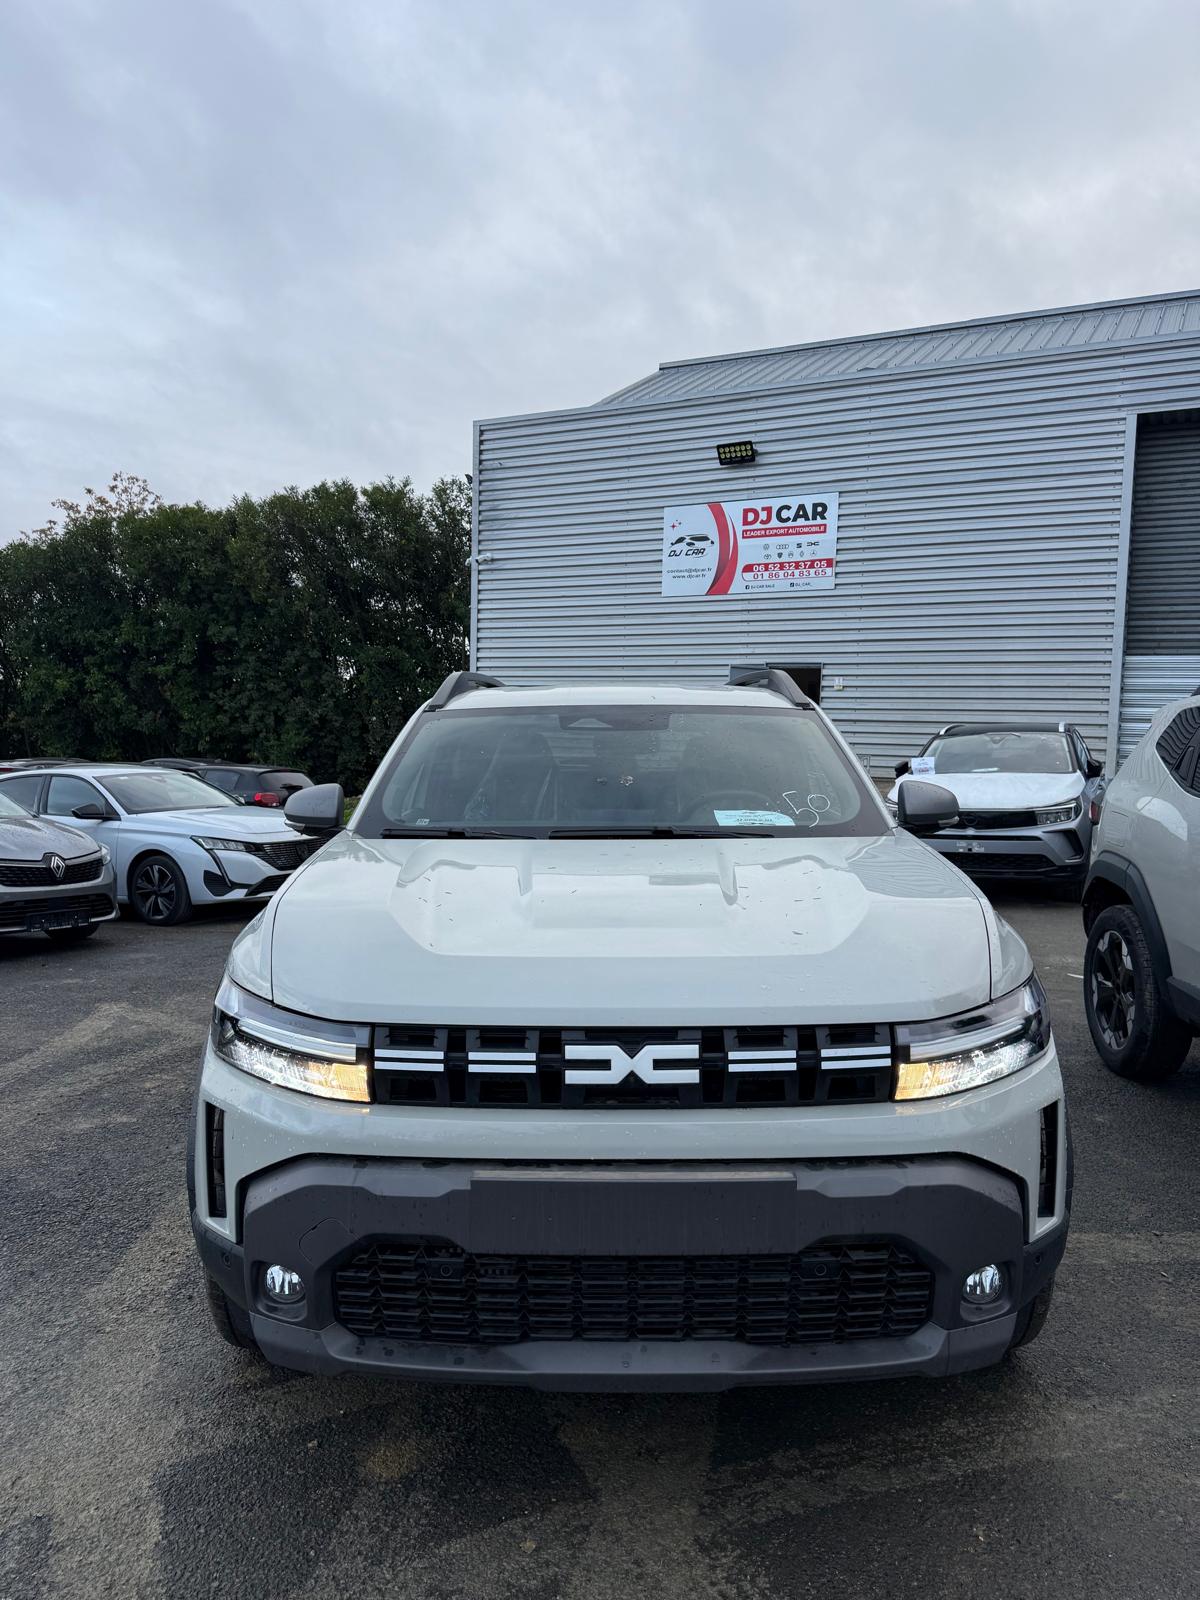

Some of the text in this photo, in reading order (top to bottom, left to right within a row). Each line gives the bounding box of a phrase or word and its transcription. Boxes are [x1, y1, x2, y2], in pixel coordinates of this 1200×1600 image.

[742, 502, 828, 526] DJ CAR
[668, 548, 706, 558] DJ CAR
[814, 560, 827, 568] 05
[782, 791, 830, 828] 50
